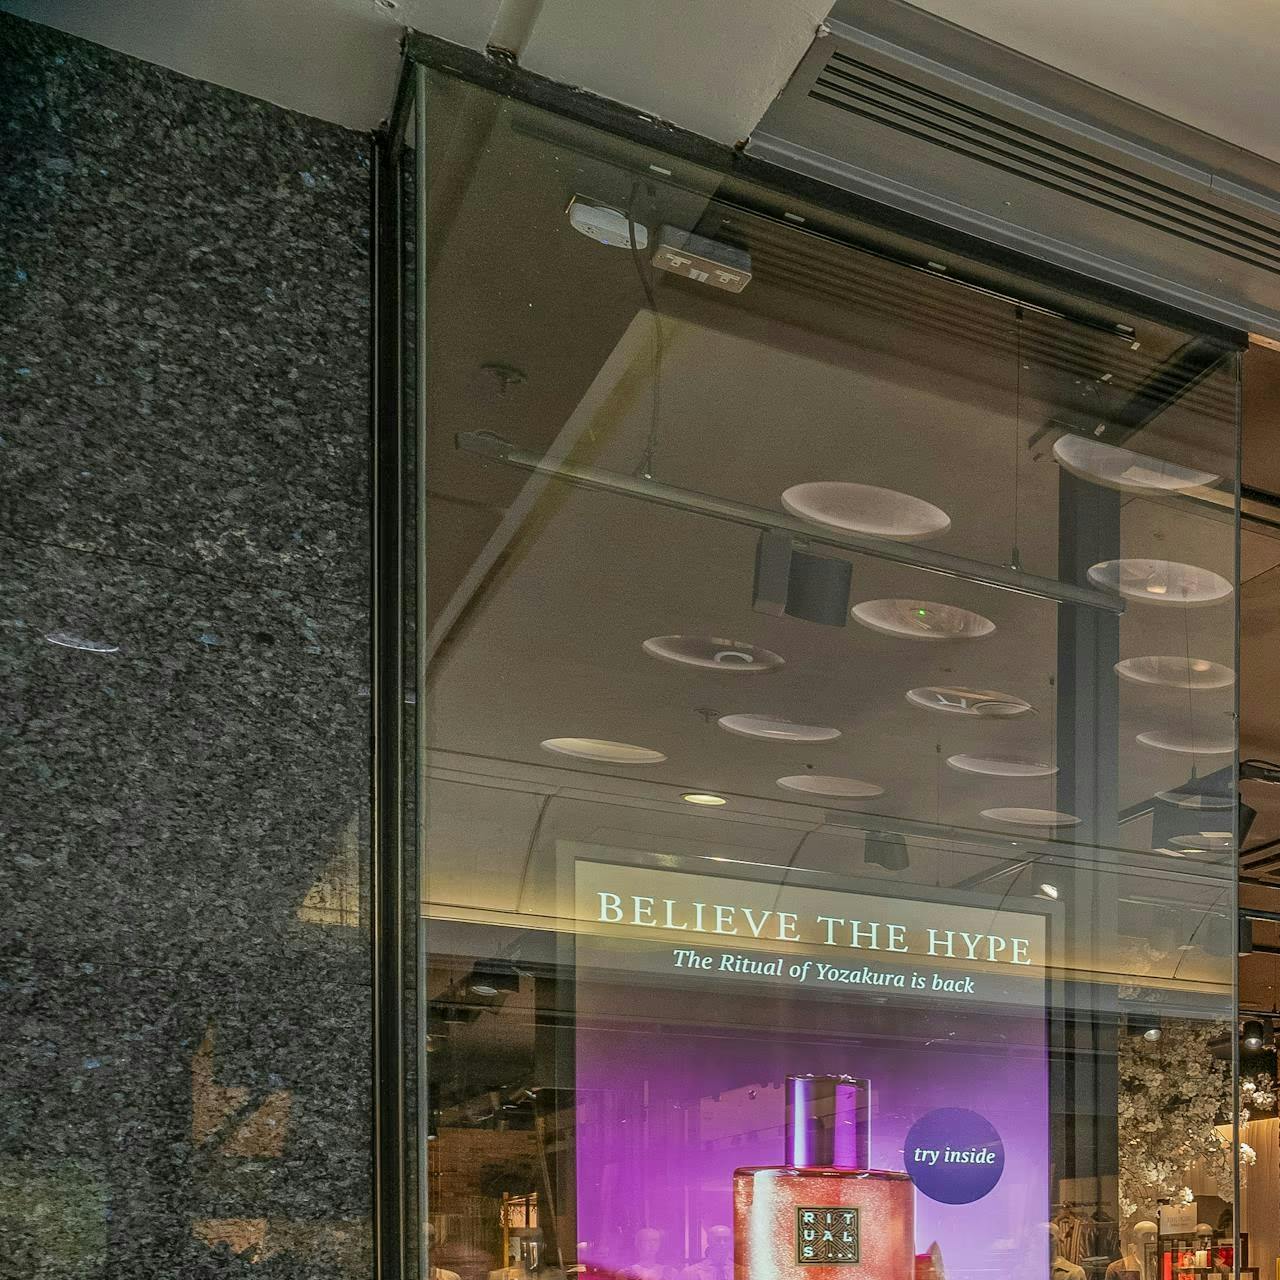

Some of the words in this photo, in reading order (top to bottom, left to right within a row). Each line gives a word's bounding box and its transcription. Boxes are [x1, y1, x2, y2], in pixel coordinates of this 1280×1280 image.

[597, 892, 801, 942] BELIEVE
[817, 915, 909, 953] THE
[926, 928, 1032, 965] HYPE
[673, 949, 713, 970] The
[718, 954, 784, 976] Ritual
[789, 961, 812, 983] of
[816, 963, 905, 987] Yozakura
[911, 972, 926, 989] is
[932, 974, 975, 994] back
[914, 1146, 940, 1168] try
[944, 1146, 996, 1165] inside
